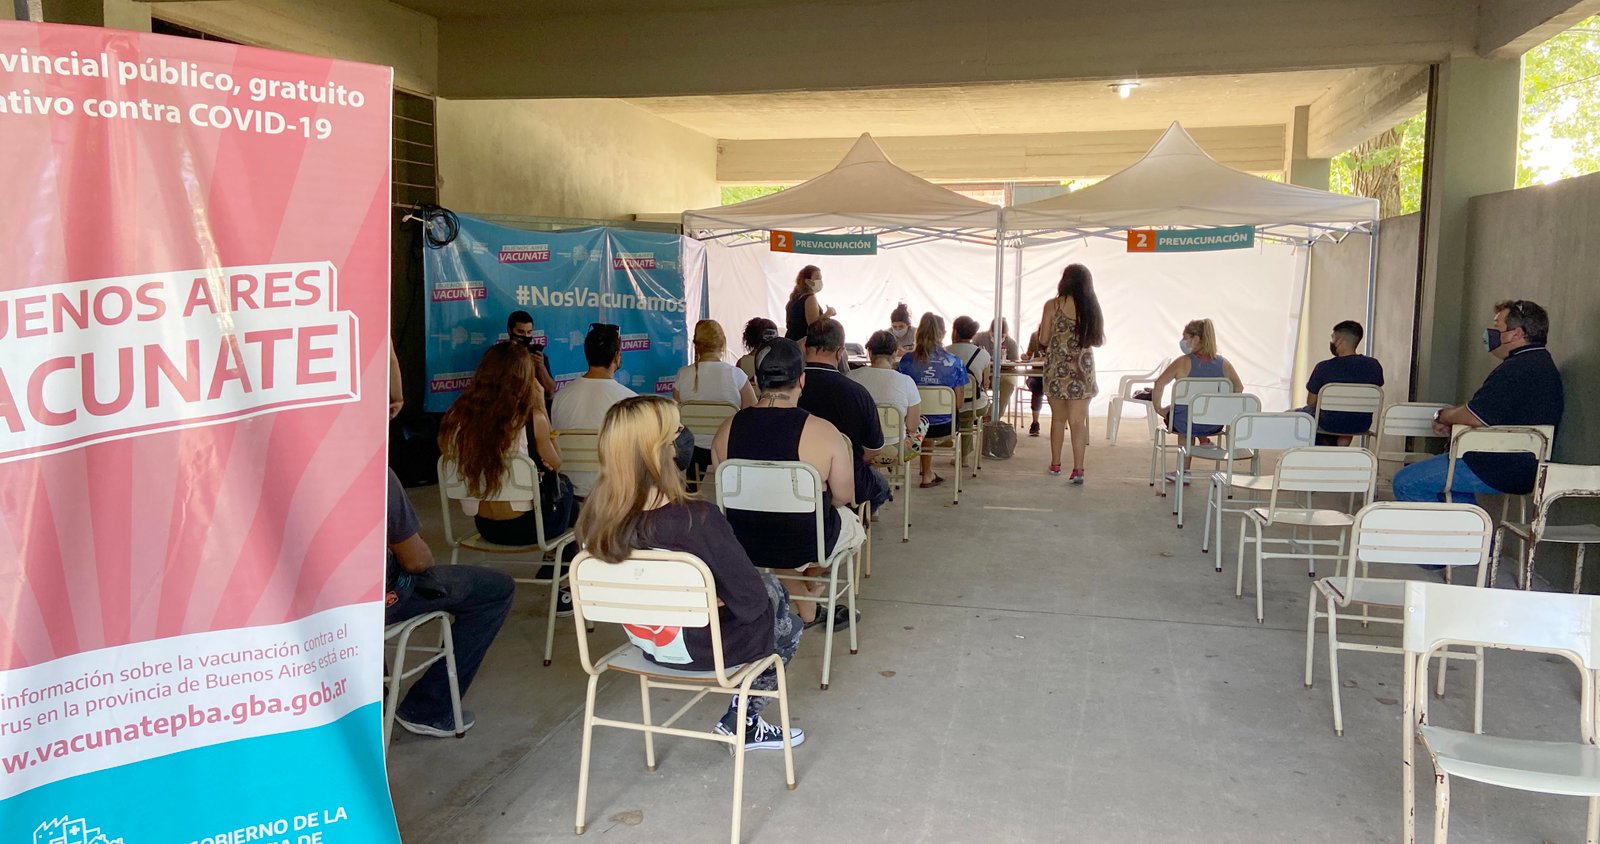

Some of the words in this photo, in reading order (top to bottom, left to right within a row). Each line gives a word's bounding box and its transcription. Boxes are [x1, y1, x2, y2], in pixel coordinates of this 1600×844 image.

[0, 47, 109, 78] vincial
[117, 56, 241, 96] público,
[249, 76, 366, 108] gratuito
[82, 97, 182, 124] contra
[189, 103, 333, 140] COVID-19
[777, 234, 787, 248] 2
[795, 239, 871, 249] PREVACUNACIÓN
[1136, 233, 1147, 248] 2
[1159, 232, 1248, 246] PREVACUNACIÓN
[499, 251, 549, 262] VACUNATE
[433, 288, 485, 300] VACUNATE
[516, 285, 687, 313] #NosVacunamos
[621, 340, 649, 350] UNATE
[431, 378, 473, 391] VACUNA
[1, 669, 114, 711] información
[119, 660, 173, 682] sobre
[177, 655, 194, 671] la
[198, 641, 300, 668] vacunación
[304, 632, 334, 653] contra
[336, 623, 348, 639] el
[1, 716, 32, 736] rus
[37, 708, 58, 726] en
[63, 701, 79, 718] la
[85, 684, 173, 717] provincia
[177, 678, 200, 694] de
[206, 669, 274, 689] Buenos
[278, 660, 317, 679] Aires
[318, 650, 338, 669] está
[339, 645, 359, 660] en:
[1, 677, 348, 774] w.vacunatepba.gba.gob.ar
[293, 812, 319, 831] DE
[324, 807, 348, 824] LA
[298, 832, 323, 844] DE
